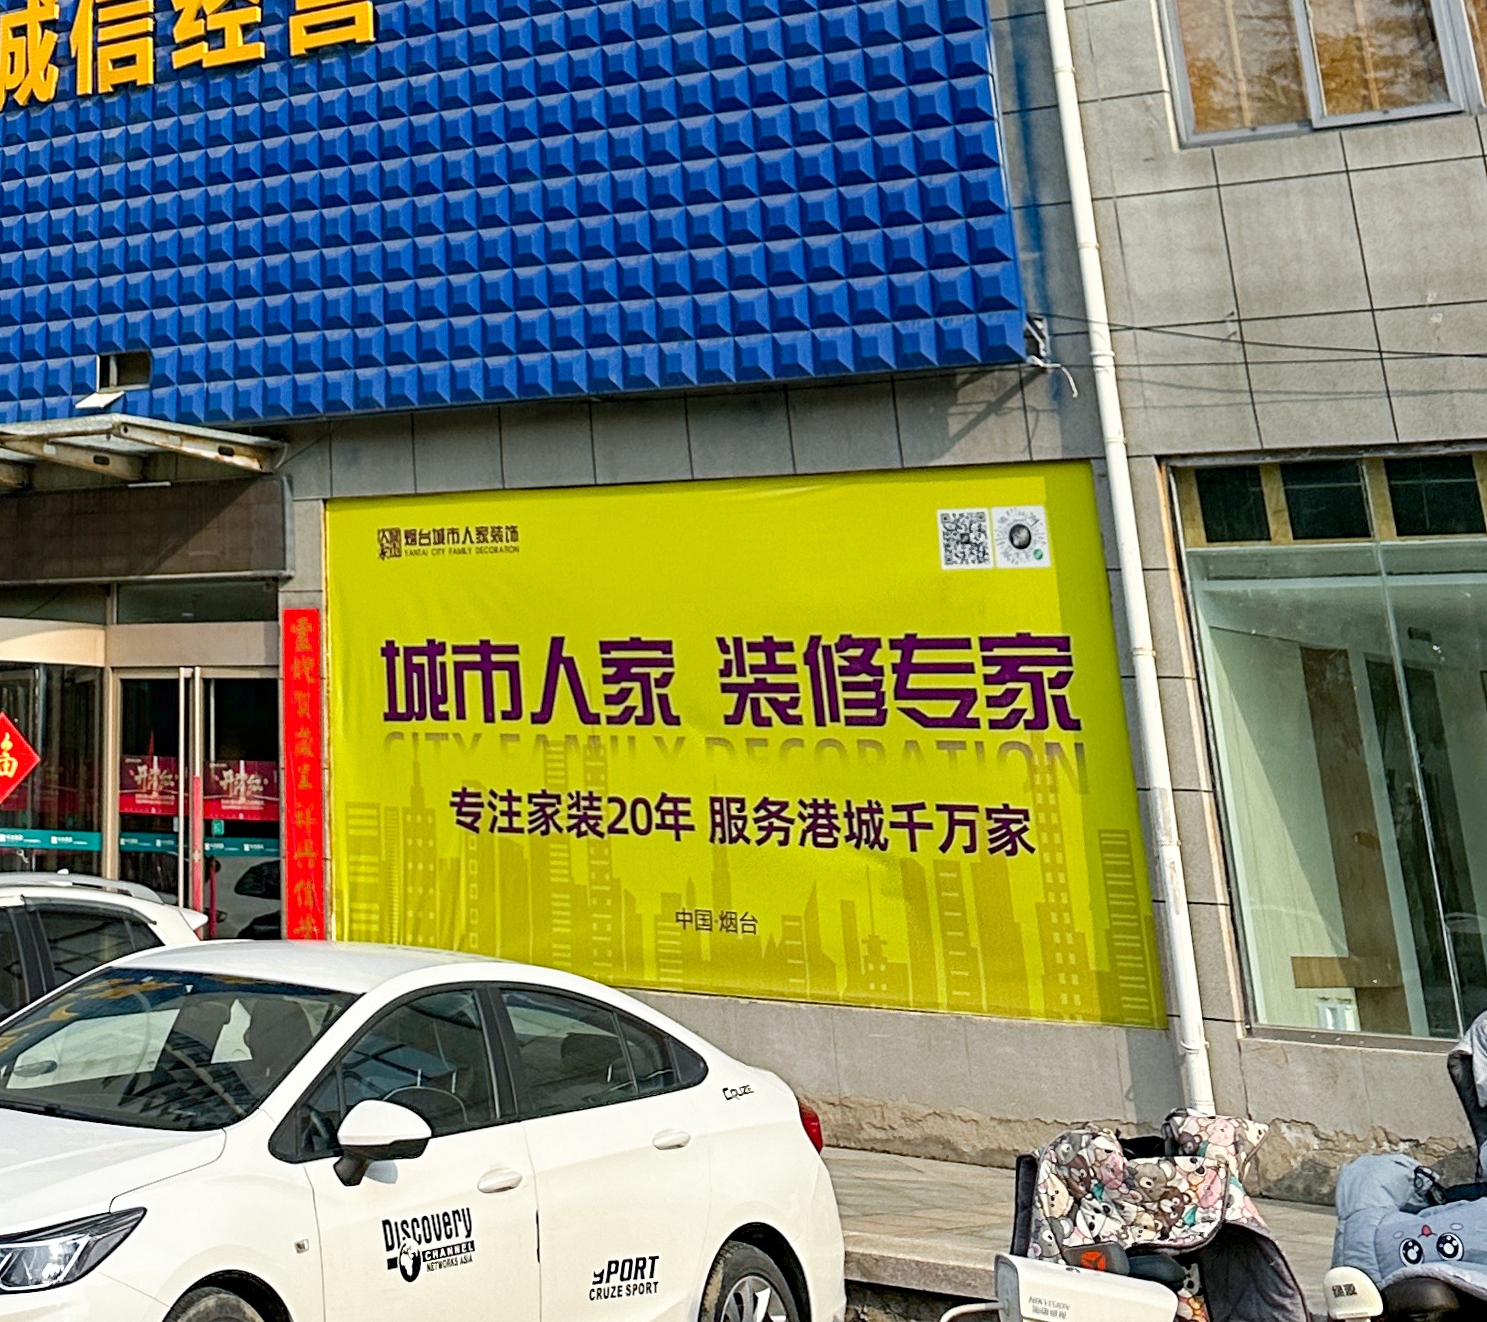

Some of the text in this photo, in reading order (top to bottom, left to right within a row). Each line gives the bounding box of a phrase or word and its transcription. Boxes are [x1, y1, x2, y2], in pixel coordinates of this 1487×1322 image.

[380, 632, 1083, 732] 城市人家 装修专家
[449, 786, 1037, 857] 专注家装20年 服务港城千万家
[674, 908, 759, 935] 中国·烟台
[423, 1241, 475, 1262] CHANNEL
[426, 1253, 474, 1273] NETWORKS ASIA
[588, 1281, 659, 1302] CRUZE SPORT
